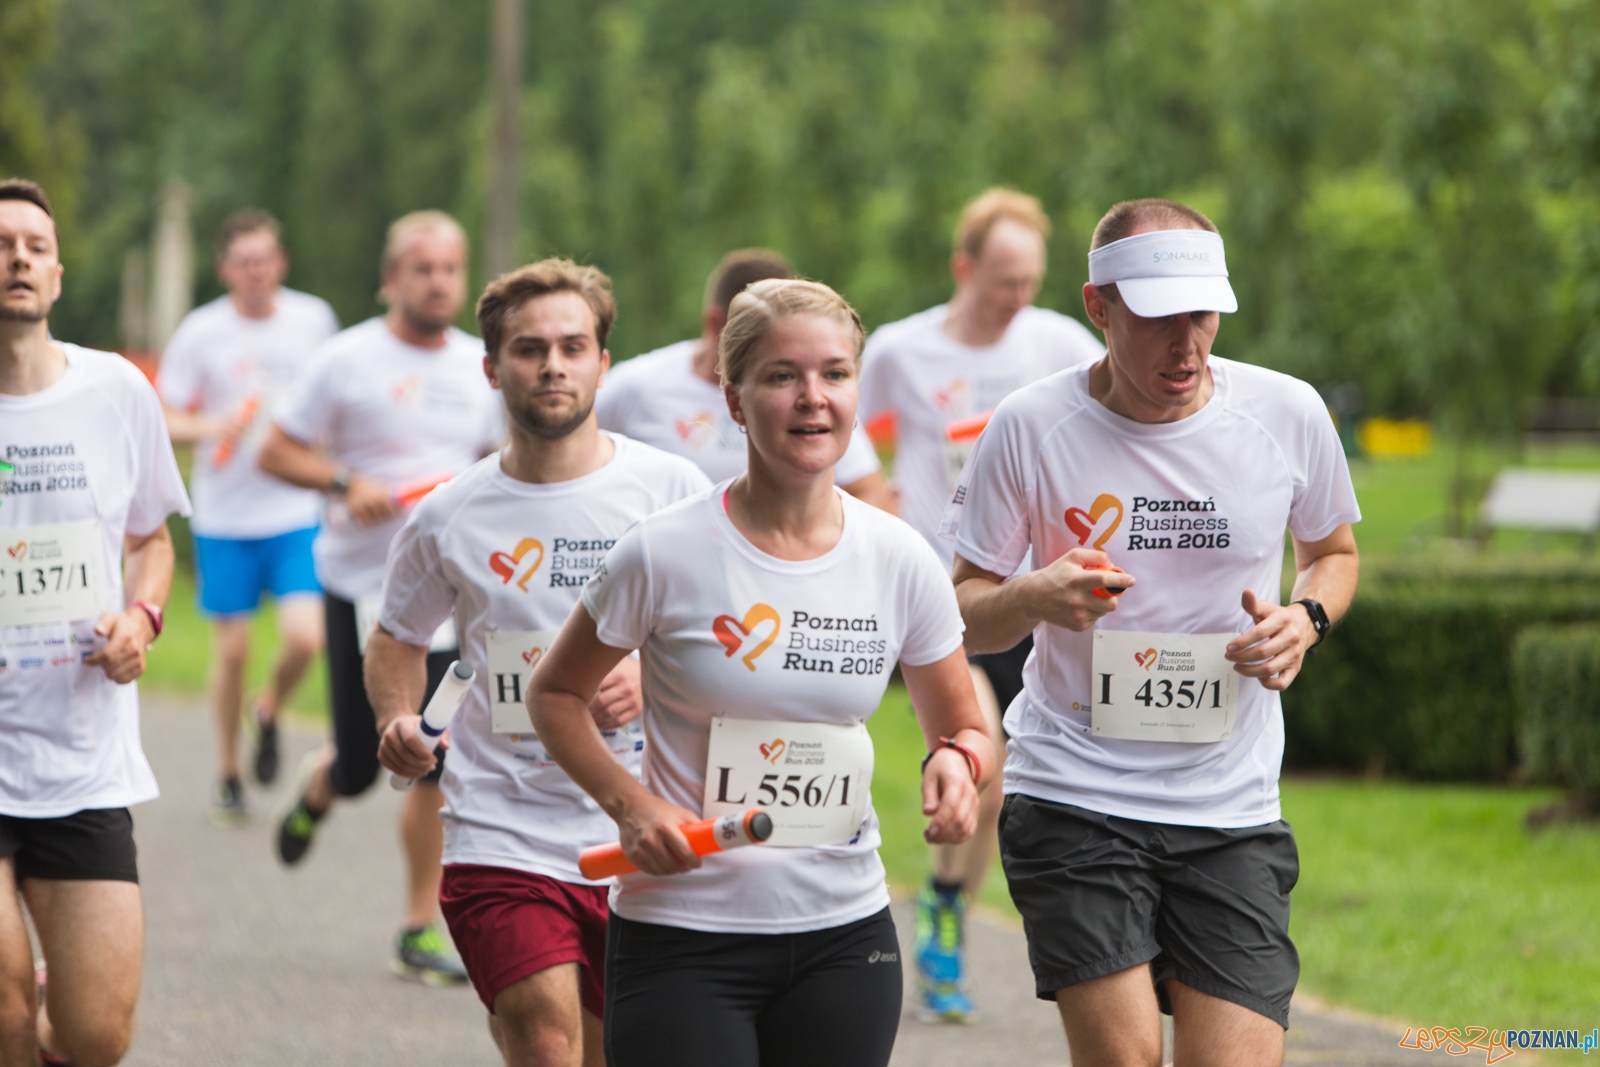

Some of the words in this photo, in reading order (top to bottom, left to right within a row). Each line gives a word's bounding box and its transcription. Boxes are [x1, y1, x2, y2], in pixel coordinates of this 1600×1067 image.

[1153, 251, 1210, 263] SONALAKE
[6, 441, 76, 459] Poznań
[12, 461, 86, 477] usiness
[45, 476, 88, 492] 2016
[1132, 497, 1216, 513] Poznań
[1129, 515, 1228, 532] Business
[1127, 534, 1172, 551] Run
[1177, 533, 1231, 549] 2016
[15, 563, 88, 596] 137/1
[791, 610, 878, 632] Poznań
[787, 631, 886, 654] Business
[782, 652, 834, 673] Run
[839, 657, 885, 675] 2016
[495, 673, 522, 703] H
[1098, 673, 1115, 705] I
[1134, 678, 1223, 709] 435/1
[713, 766, 747, 805] L
[757, 774, 850, 808] 556/1
